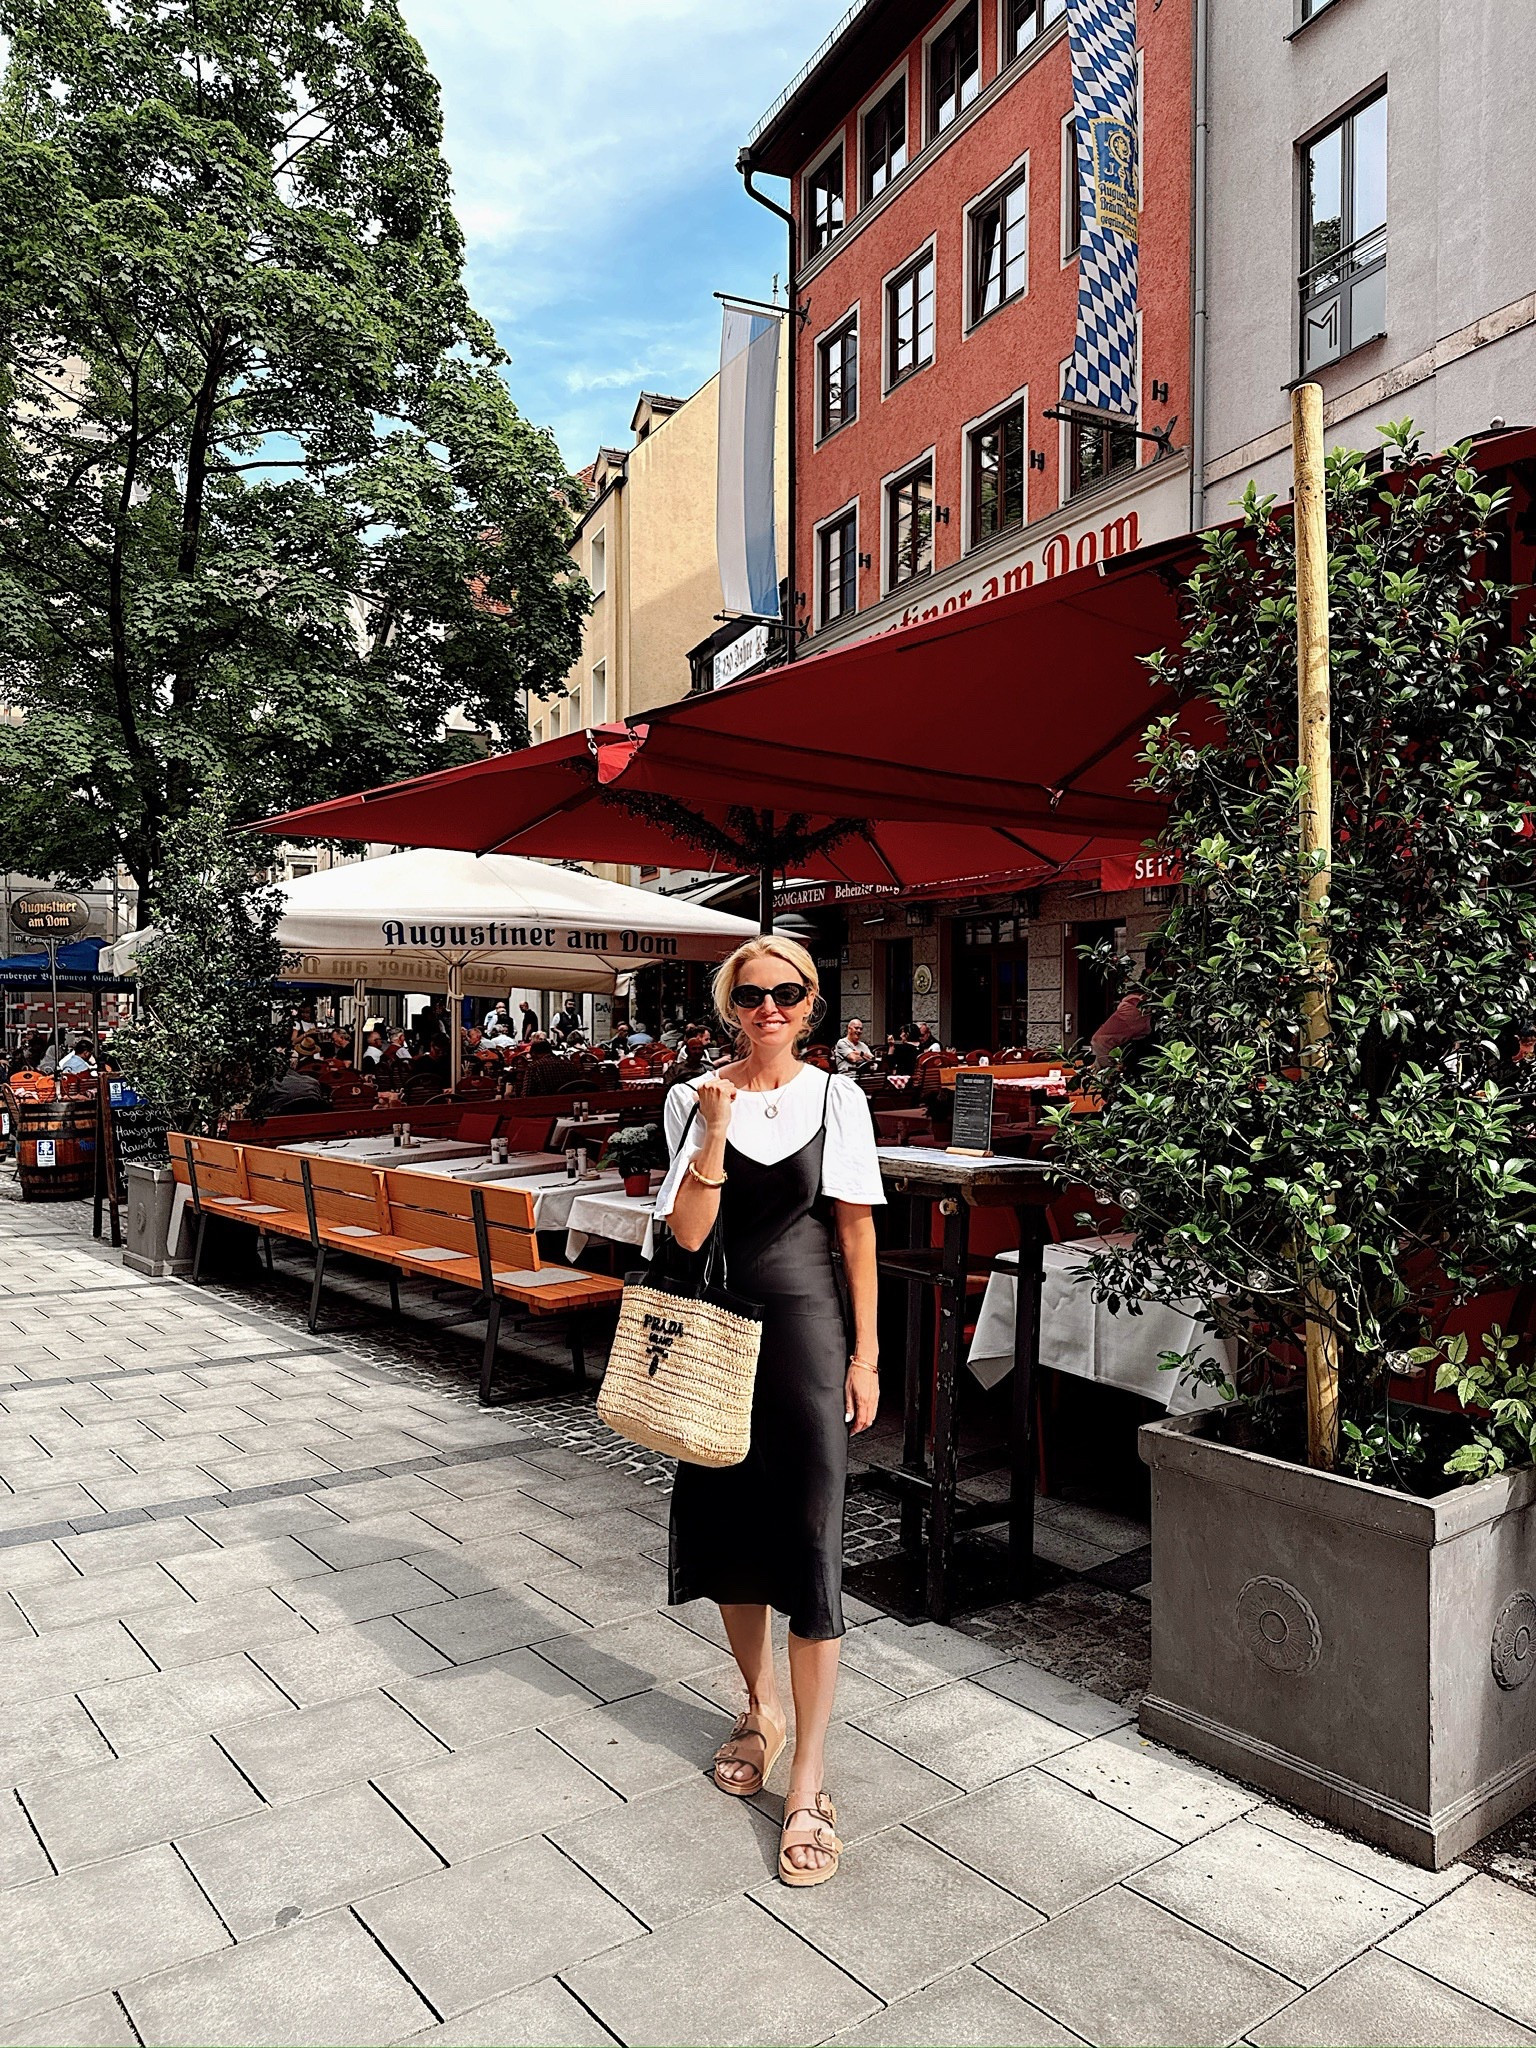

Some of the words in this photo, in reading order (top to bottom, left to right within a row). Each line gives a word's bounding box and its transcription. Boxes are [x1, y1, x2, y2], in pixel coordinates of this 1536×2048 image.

[982, 561, 1034, 602] am
[1042, 511, 1142, 580] Dom
[20, 900, 78, 915] Augustiner
[28, 917, 44, 928] am
[45, 914, 70, 928] Dom
[382, 920, 556, 948] Augustiner
[567, 929, 608, 951] am
[620, 929, 678, 955] Dom
[120, 1138, 158, 1155] Ravioli
[643, 1314, 684, 1338] PRADA
